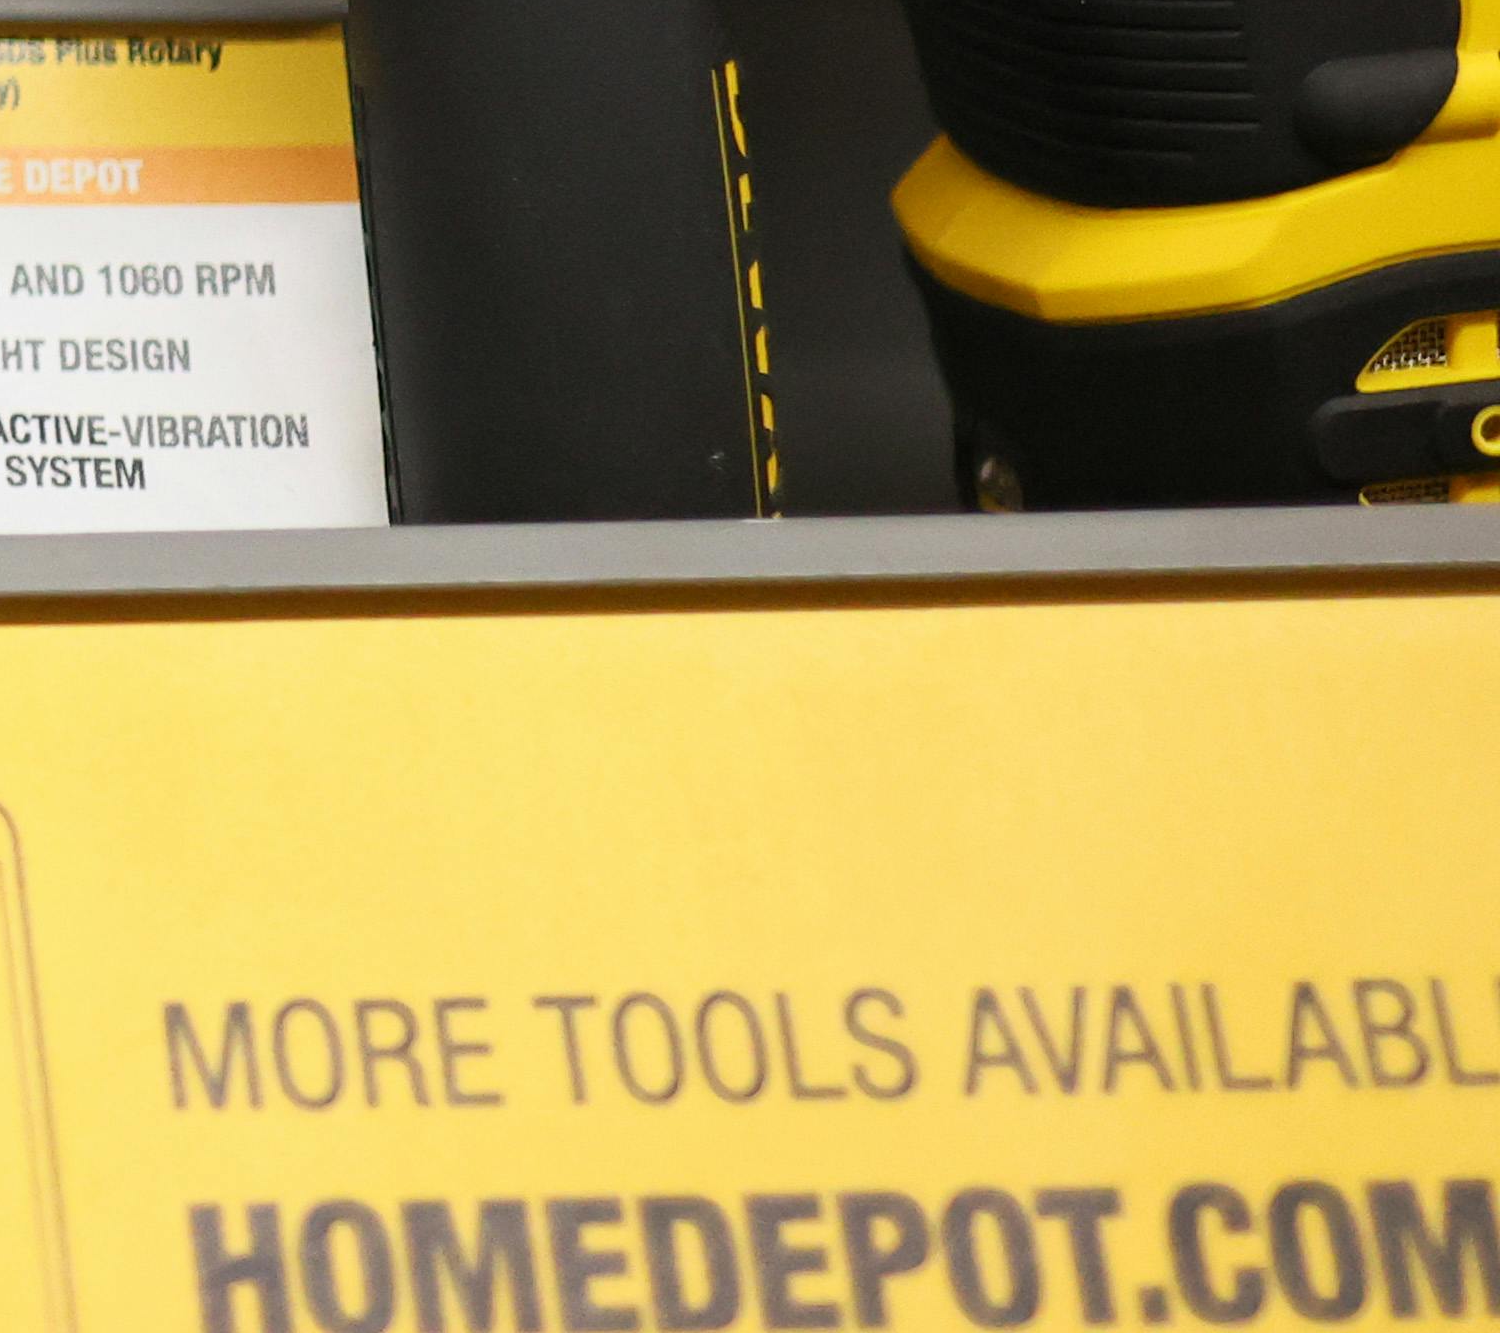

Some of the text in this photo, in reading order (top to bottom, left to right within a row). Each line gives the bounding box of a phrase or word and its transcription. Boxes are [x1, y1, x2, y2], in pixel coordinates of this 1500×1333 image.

[54, 37, 117, 64] Plus
[126, 37, 223, 72] Rotary
[24, 157, 145, 193] DEPOT
[10, 264, 84, 296] AND
[96, 264, 185, 296] 1060
[195, 263, 277, 296] RPM
[58, 338, 192, 372] DESIGN
[5, 456, 147, 491] SYSTEM
[163, 977, 1500, 1111] MORE TOOLS AVAILABL
[188, 1179, 1500, 1333] HOMEDEPOT.COM
